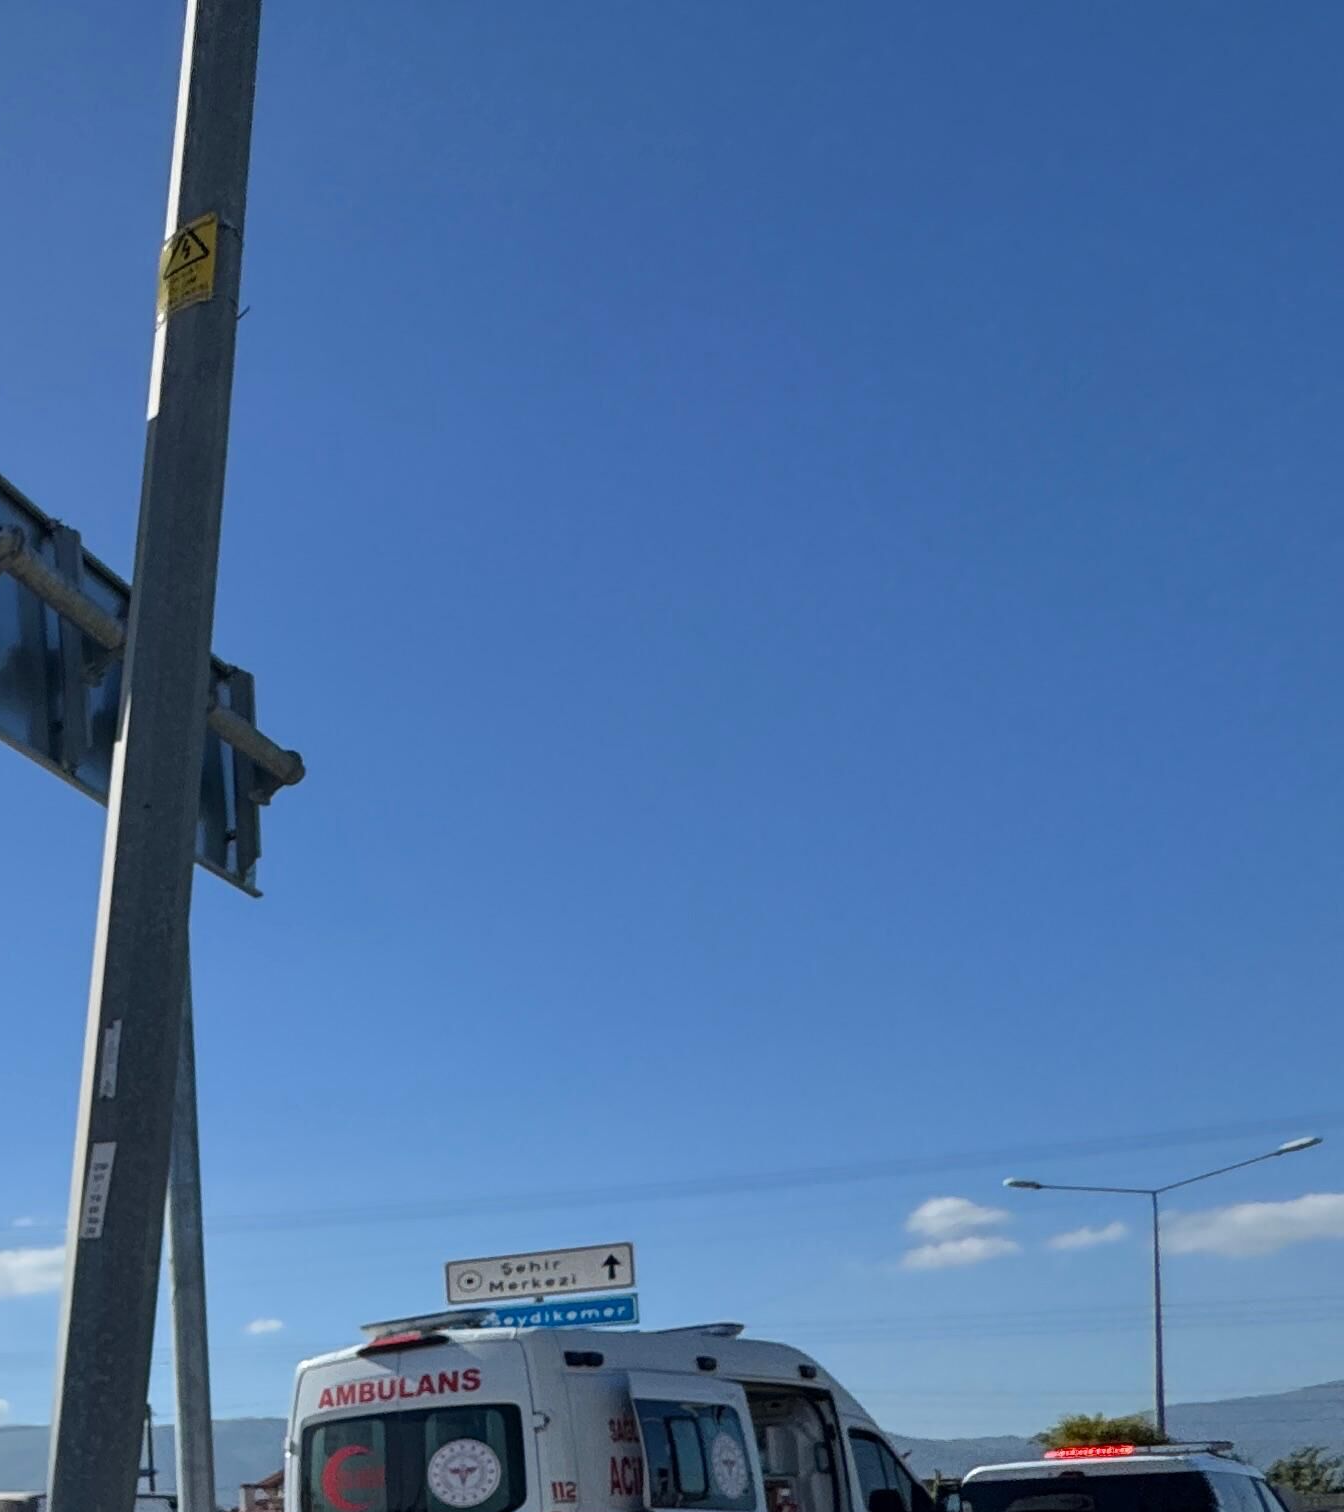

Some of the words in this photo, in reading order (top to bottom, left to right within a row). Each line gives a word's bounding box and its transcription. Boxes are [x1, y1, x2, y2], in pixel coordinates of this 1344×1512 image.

[488, 1273, 578, 1294] Merkezi
[318, 1368, 483, 1410] AMBULANS
[550, 1481, 578, 1501] 112
